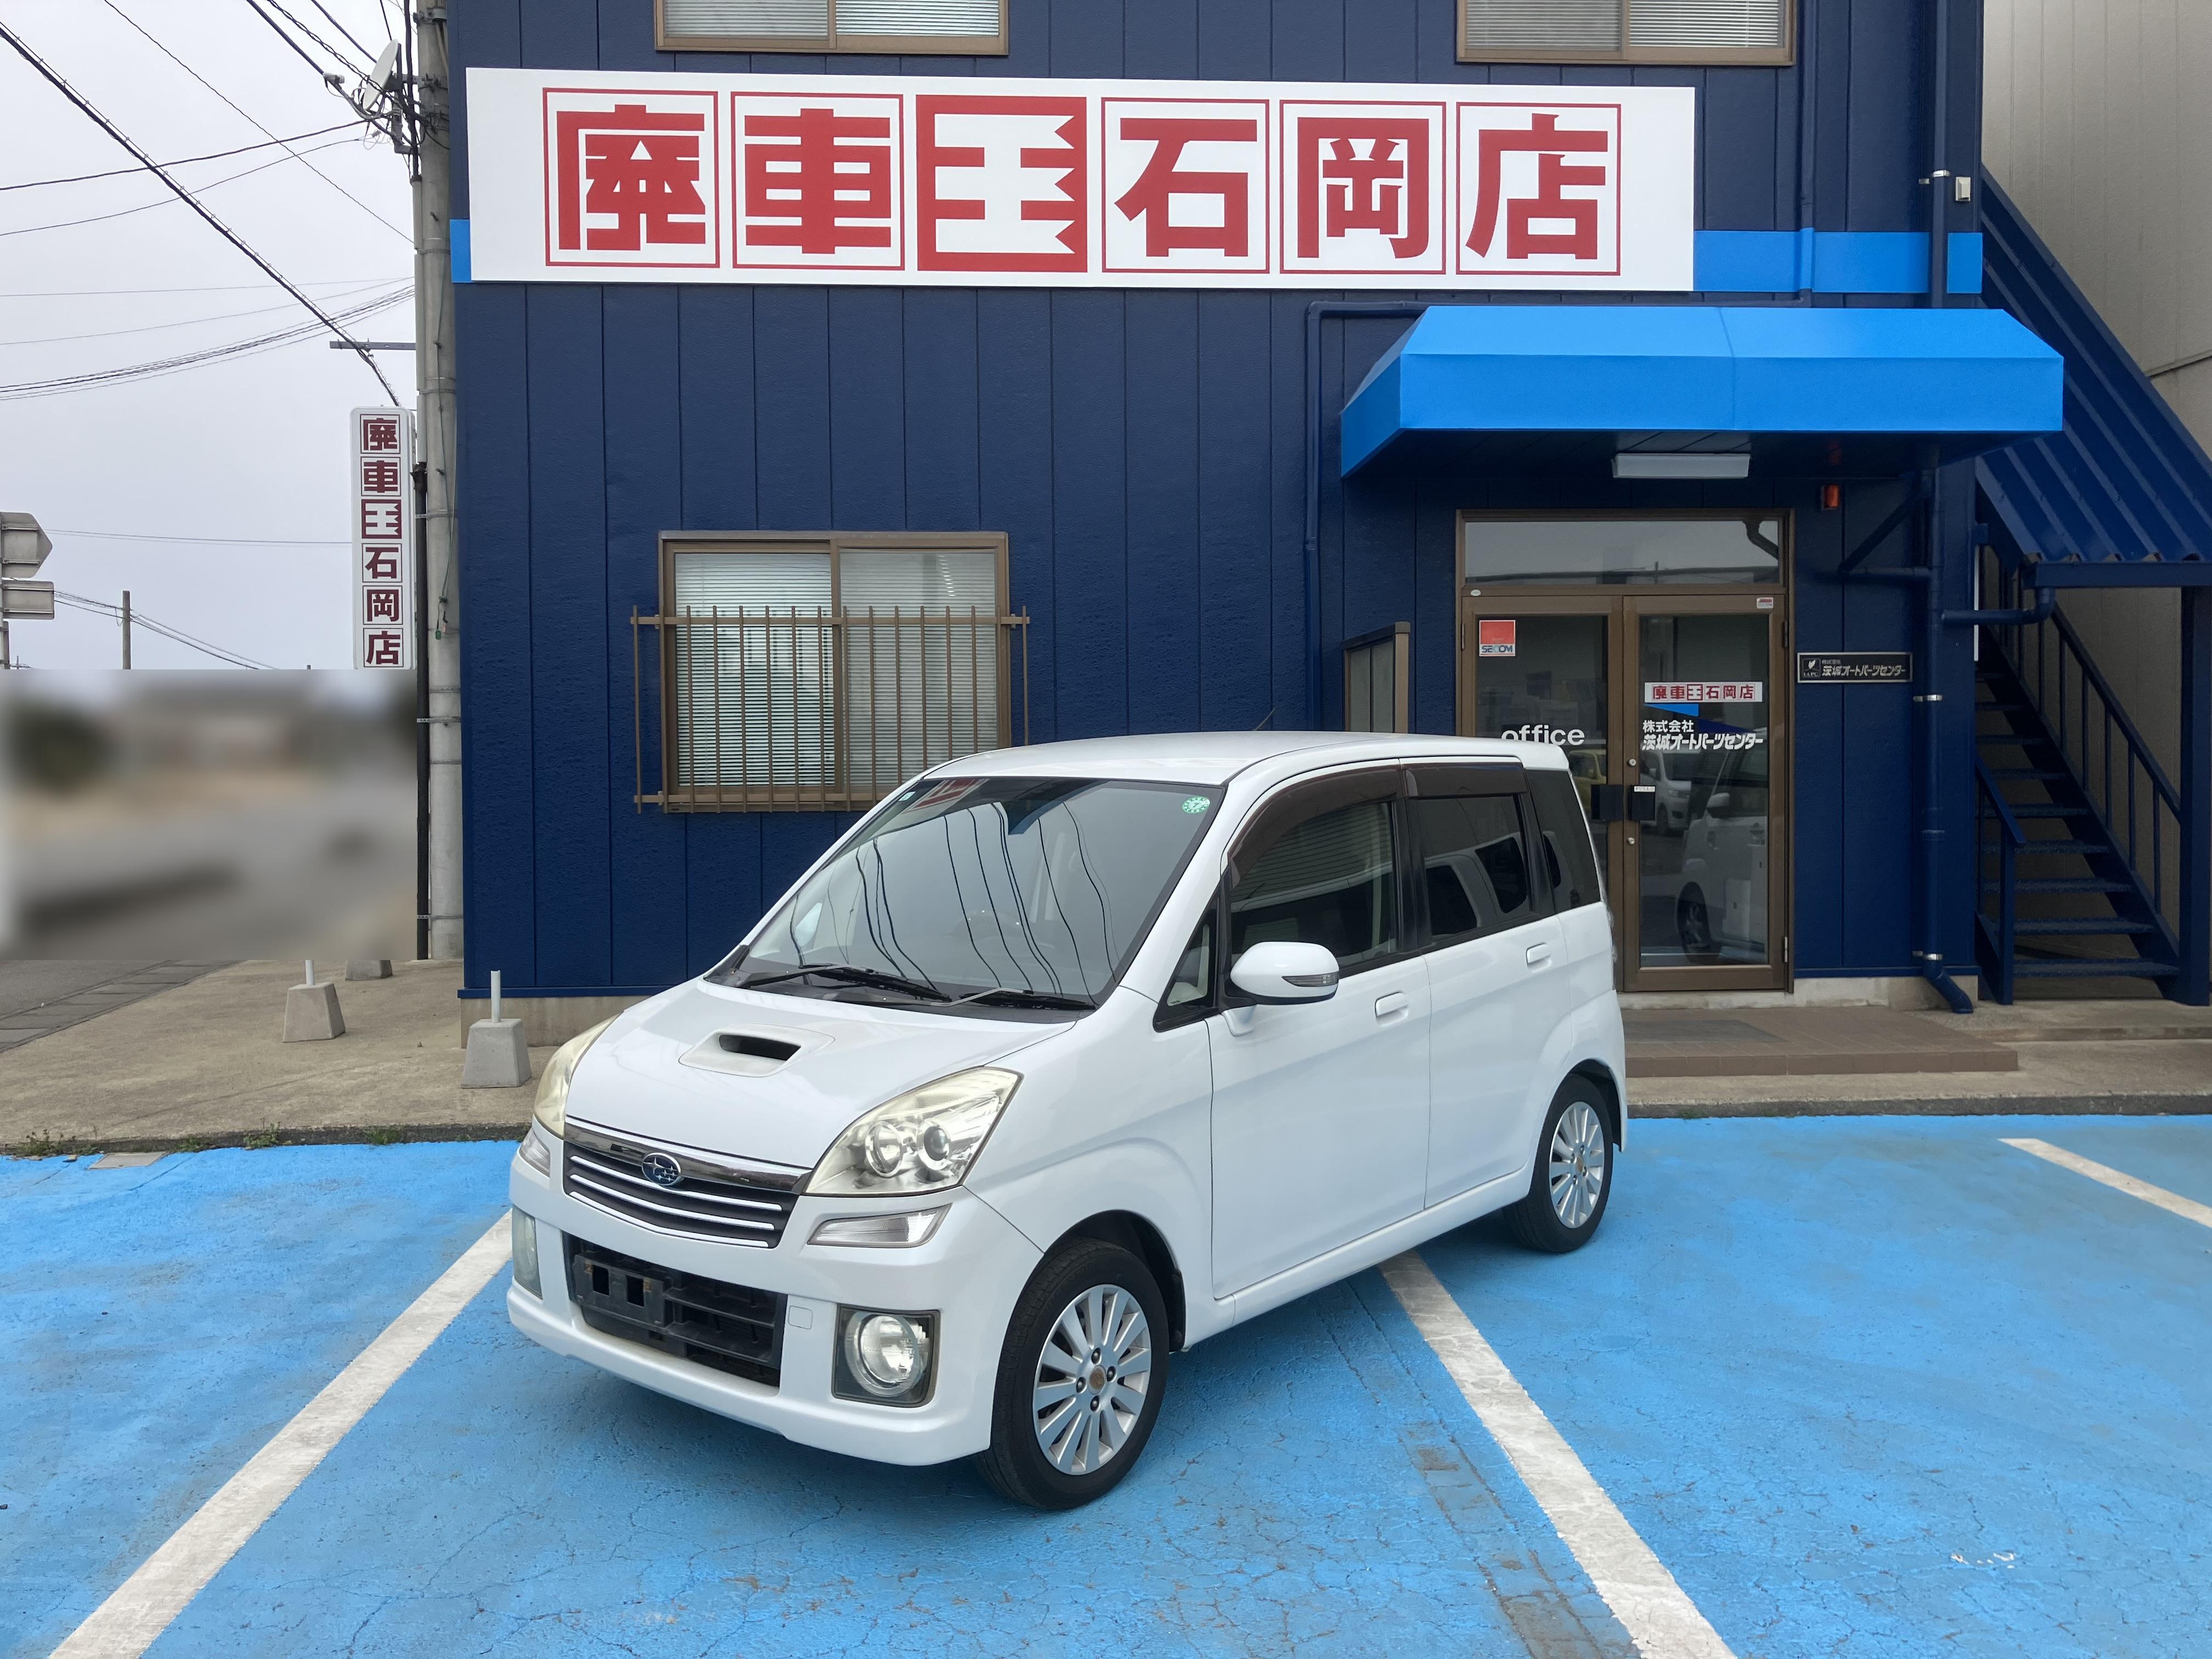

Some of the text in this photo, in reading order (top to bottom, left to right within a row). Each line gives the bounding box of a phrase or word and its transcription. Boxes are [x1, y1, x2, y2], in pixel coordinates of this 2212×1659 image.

[556, 94, 1609, 272] 廃車王石岡店
[362, 417, 402, 665] 廃車王石岡店
[1481, 645, 1513, 653] SECOM
[1501, 724, 1585, 746] office
[1642, 719, 1695, 733] 株式会社
[1641, 733, 1764, 751] 茨城オートパーツセンター
